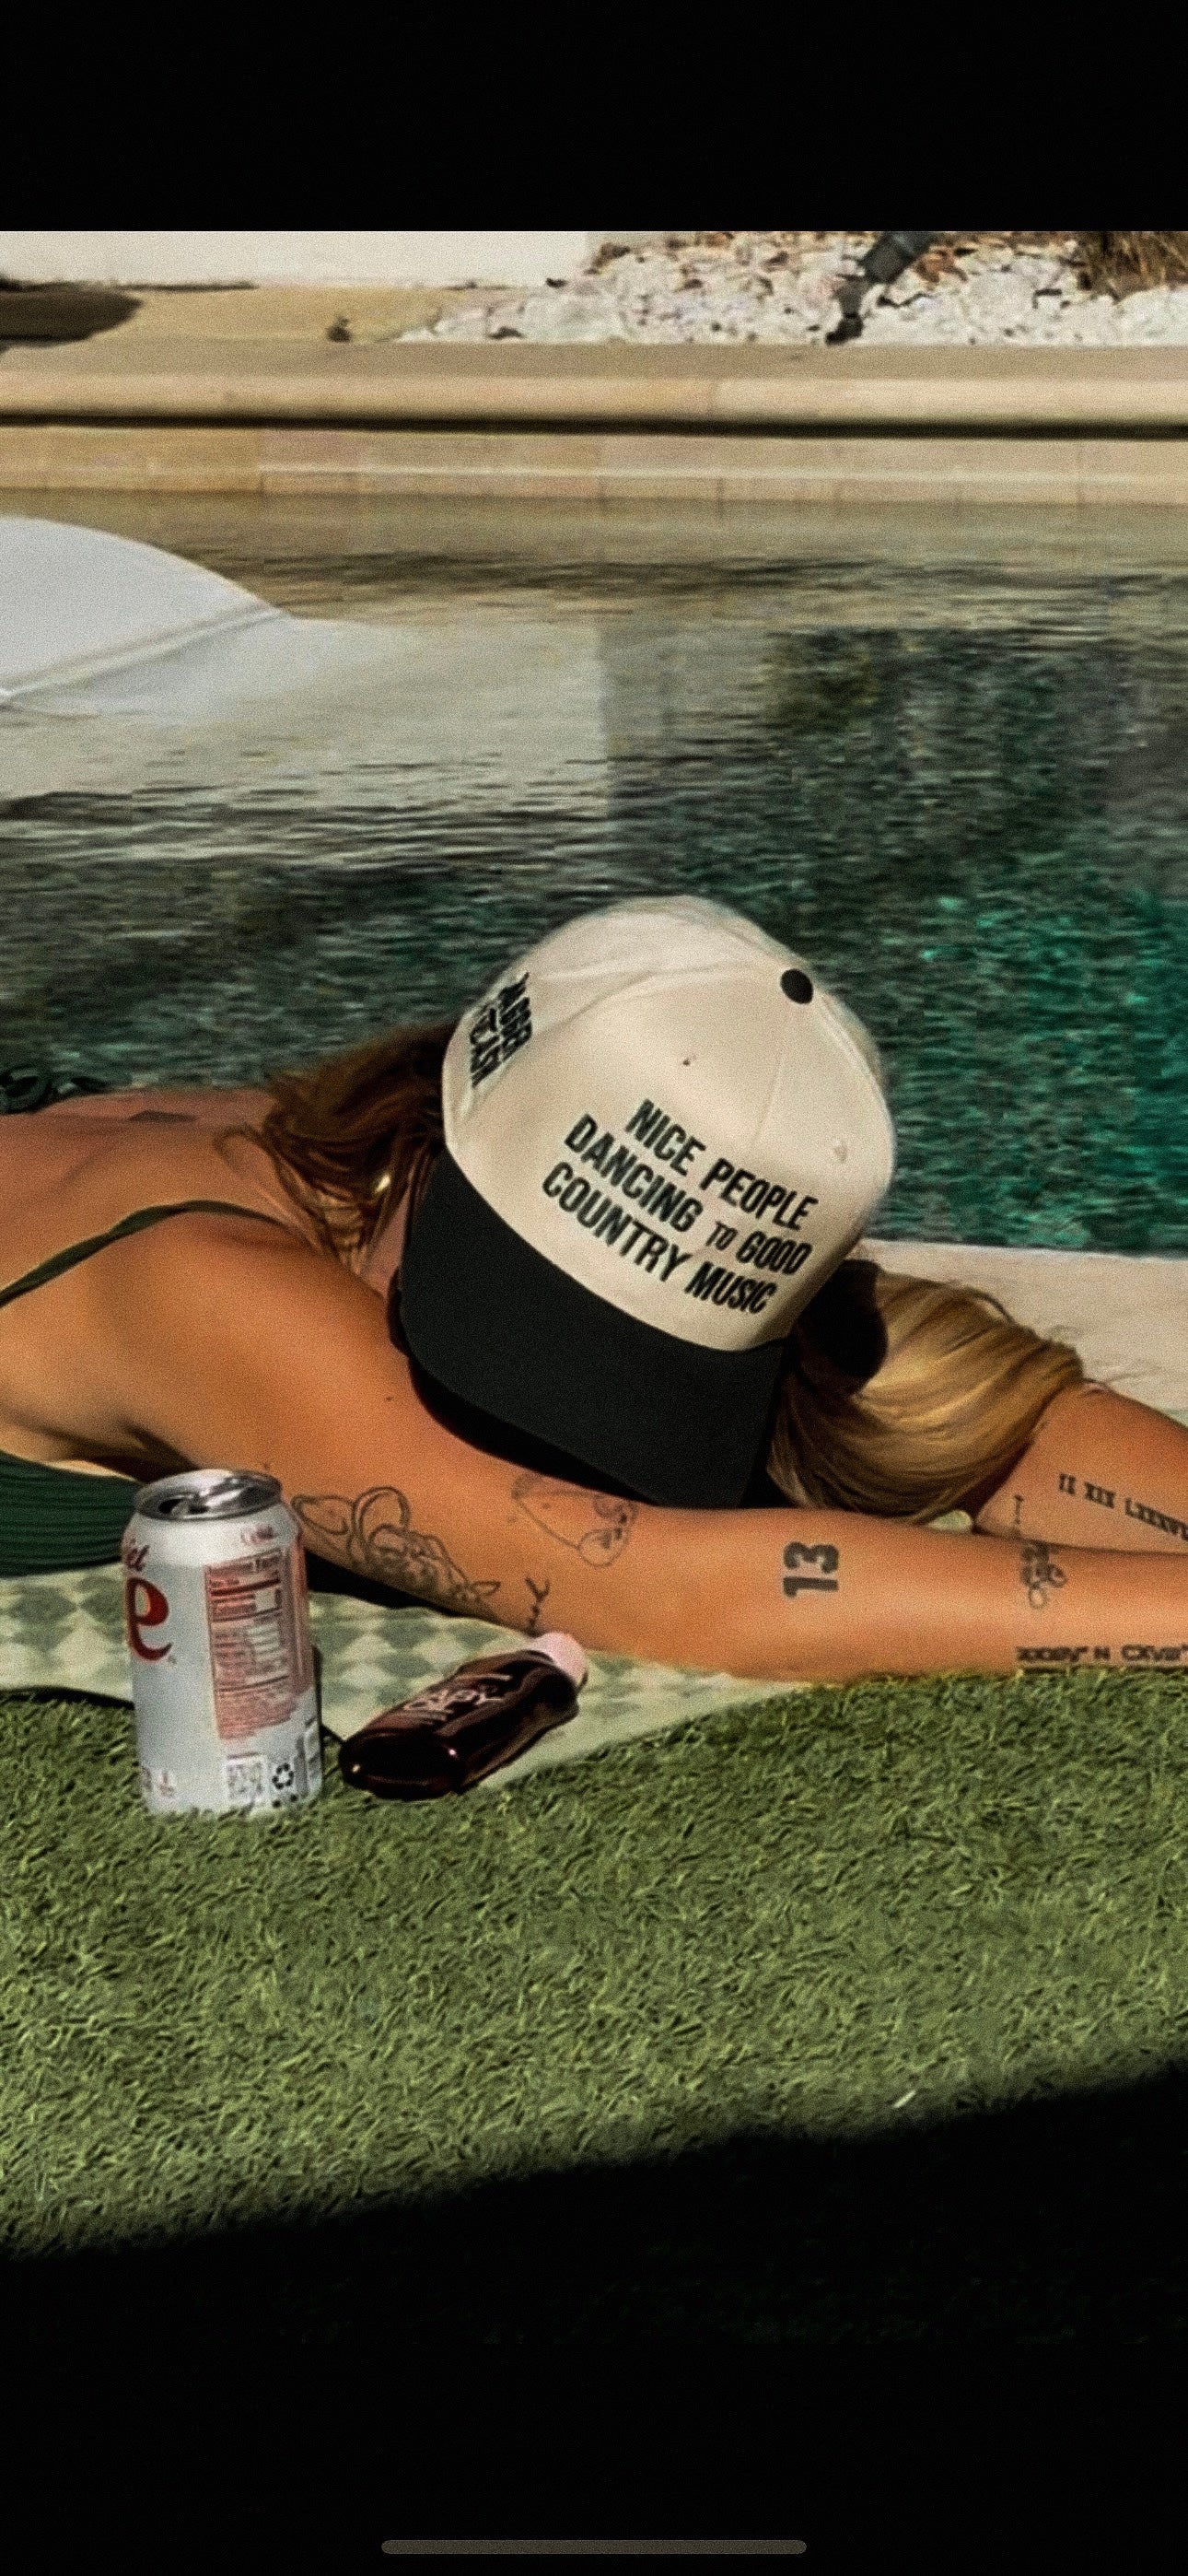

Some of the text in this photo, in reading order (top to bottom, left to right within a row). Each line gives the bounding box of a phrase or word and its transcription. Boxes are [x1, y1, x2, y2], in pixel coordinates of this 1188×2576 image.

[564, 1113, 812, 1275] DANCING TO GOOD
[624, 1098, 819, 1231] NICE PEOPLE
[542, 1162, 777, 1314] COUNTRY MUSIC
[783, 1540, 839, 1598] 13
